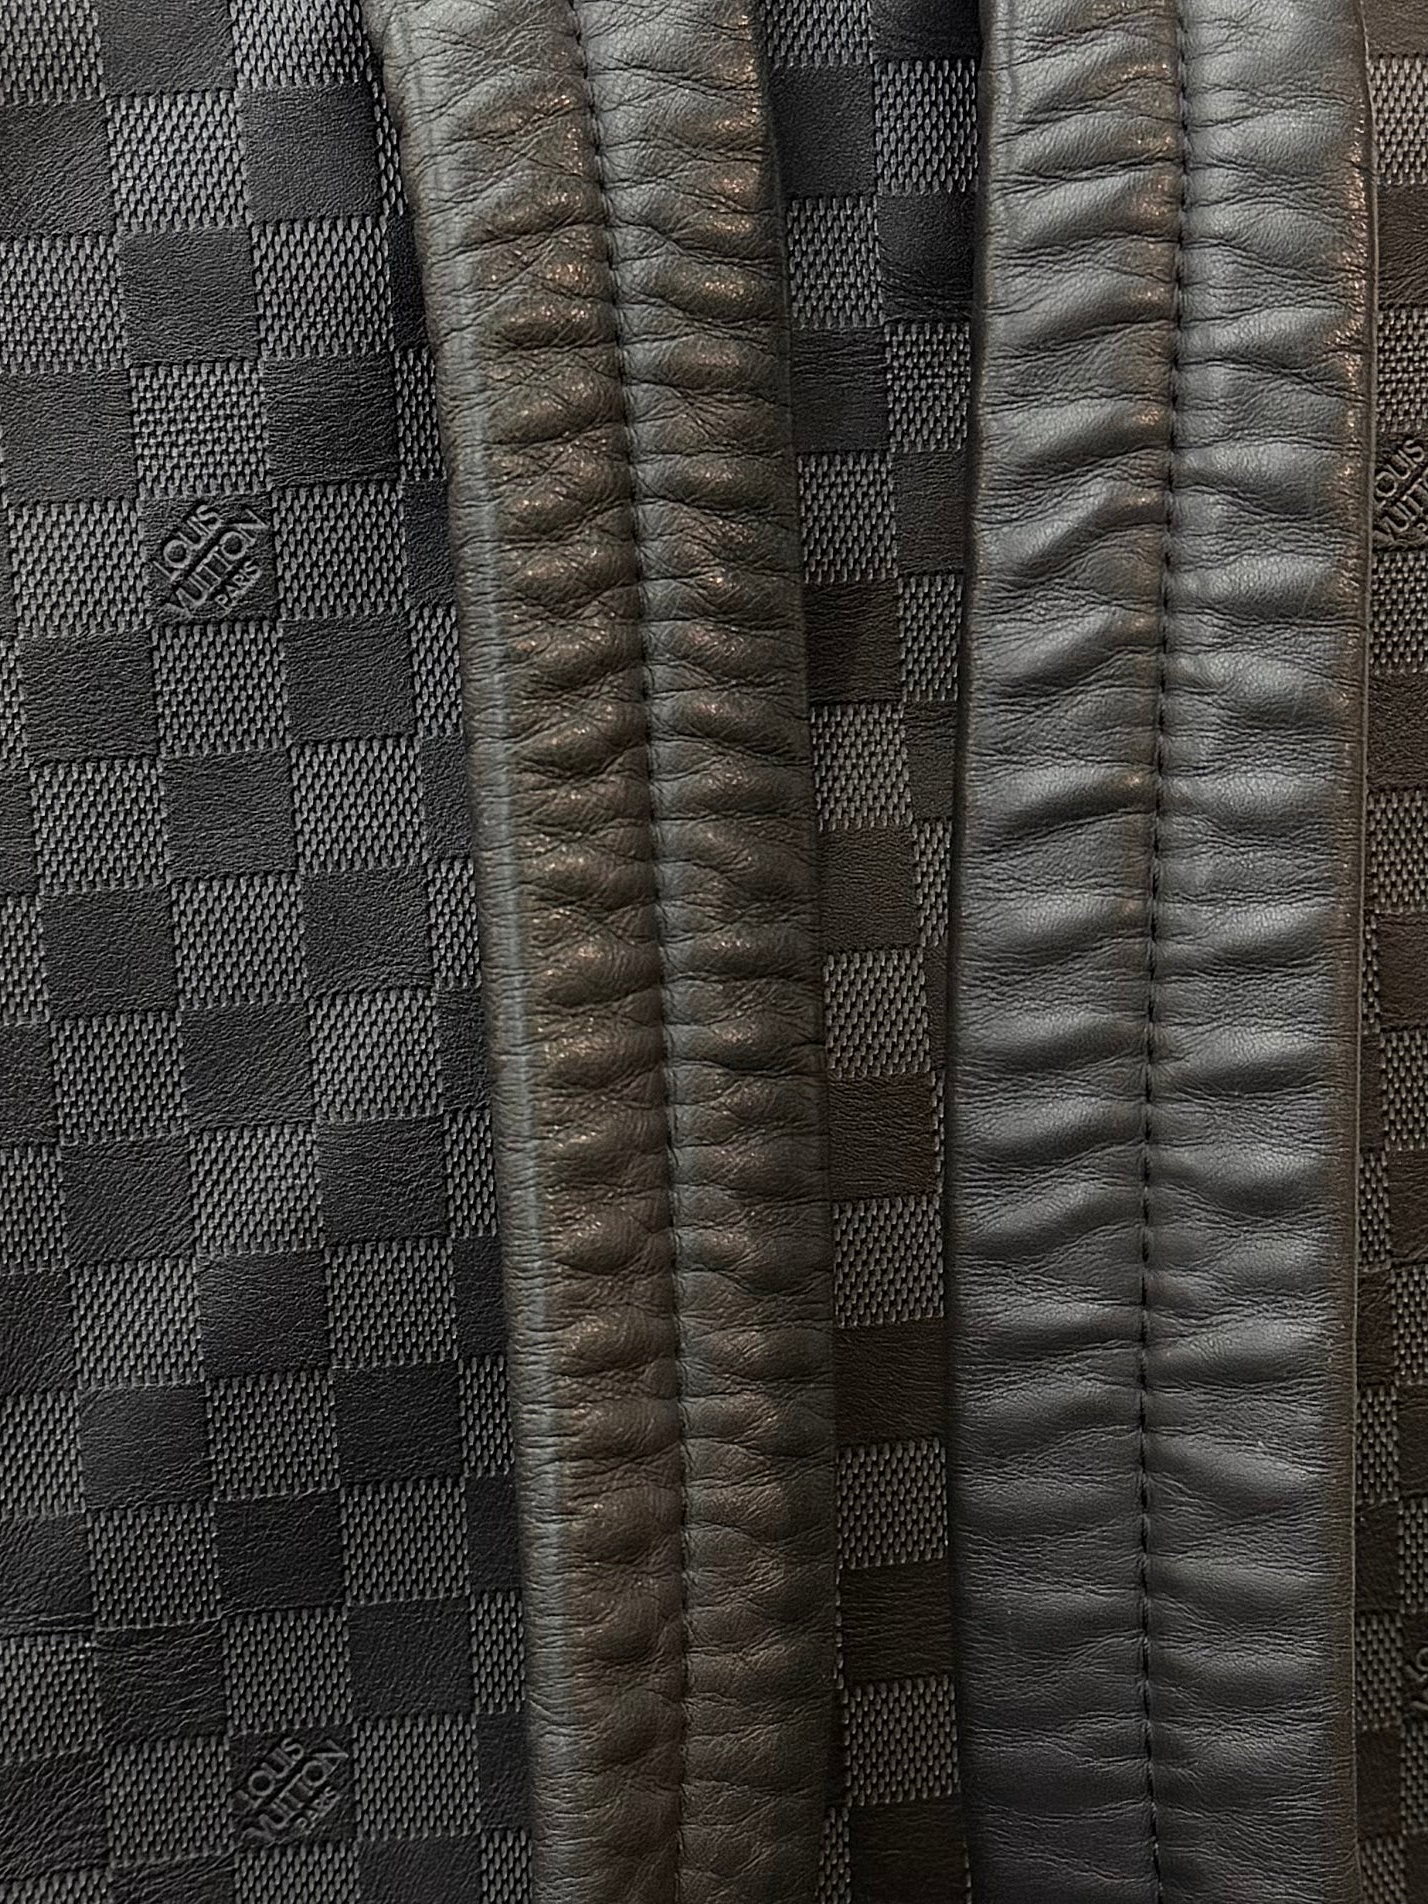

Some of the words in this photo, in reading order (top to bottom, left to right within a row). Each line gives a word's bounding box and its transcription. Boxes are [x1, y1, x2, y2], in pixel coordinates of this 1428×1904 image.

[152, 505, 223, 583] LOUIS
[165, 508, 270, 619] VUITTON
[214, 558, 262, 617] PARIS
[231, 1738, 305, 1809] LOUIS
[240, 1740, 349, 1842] VUITTON
[292, 1786, 341, 1836] PARIS
